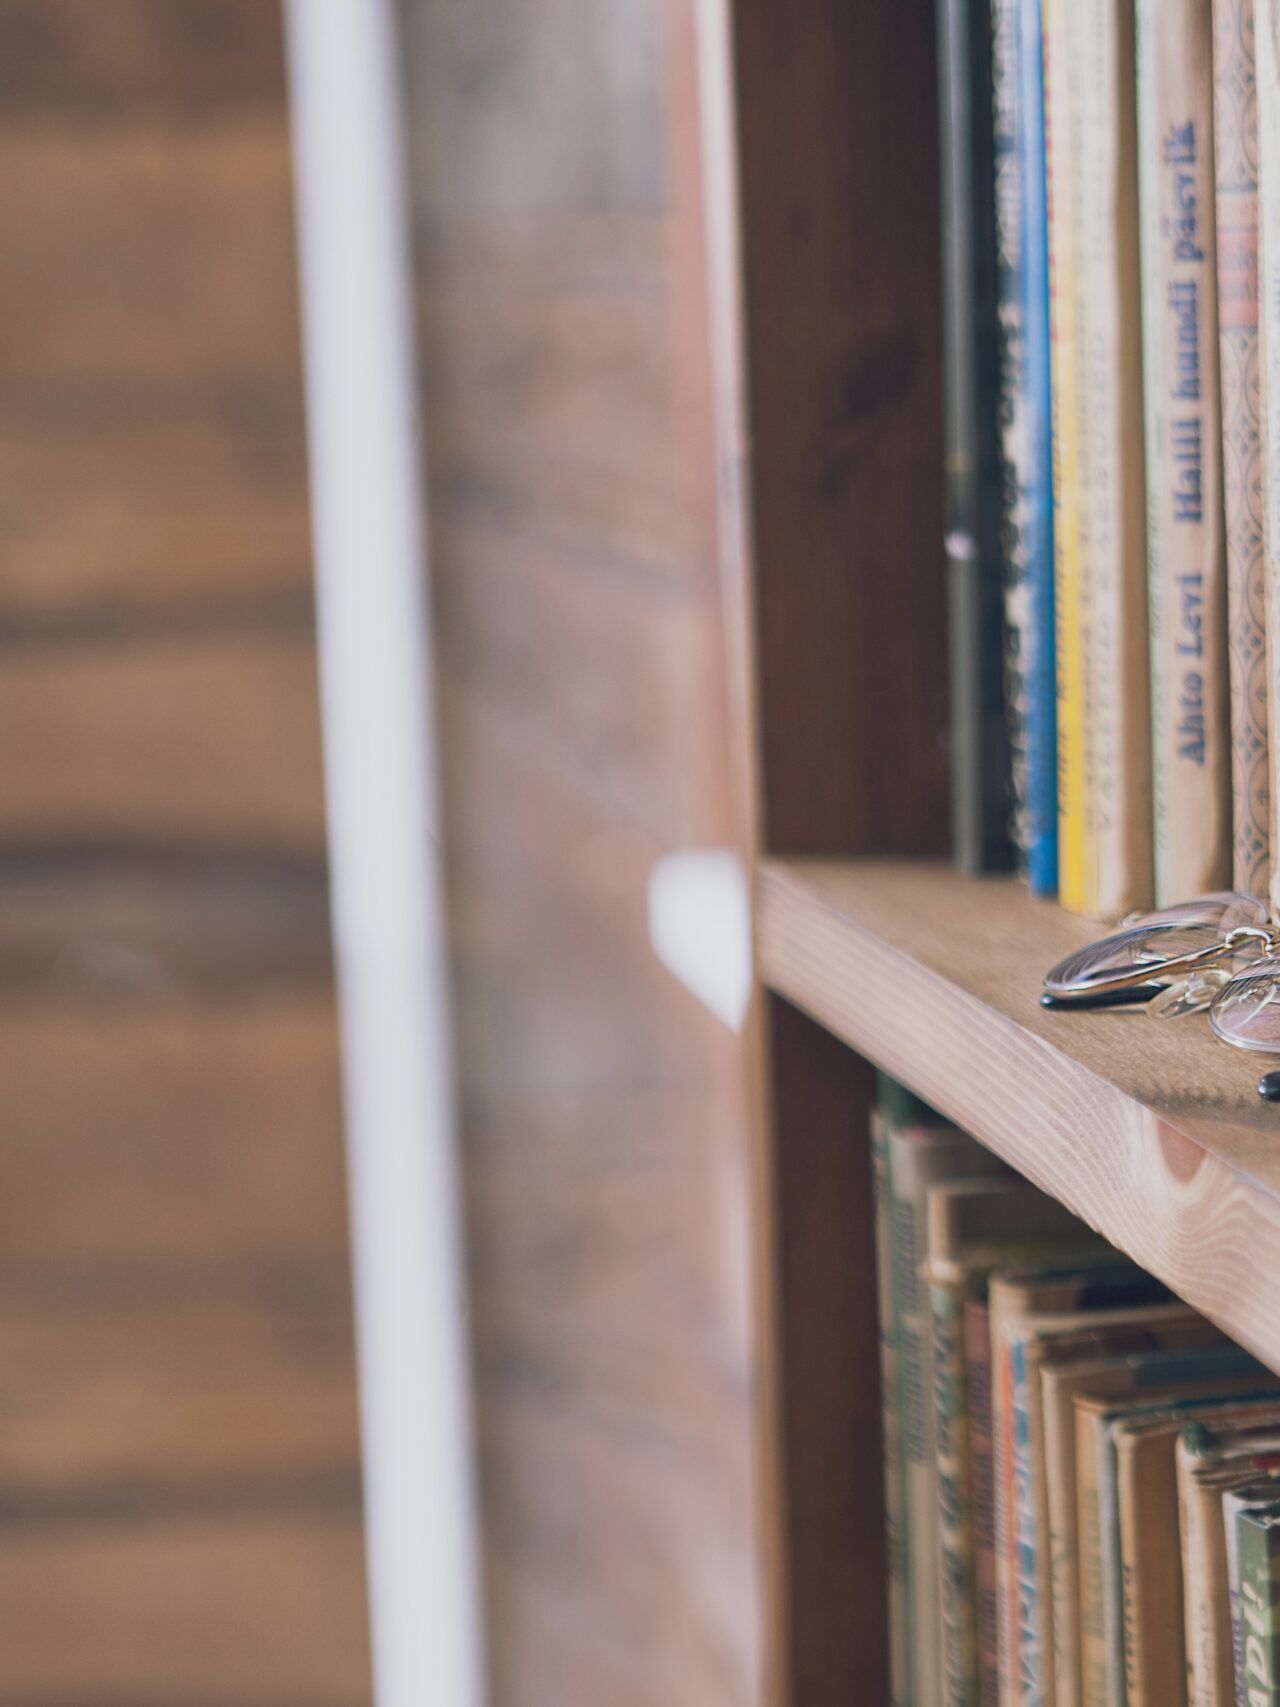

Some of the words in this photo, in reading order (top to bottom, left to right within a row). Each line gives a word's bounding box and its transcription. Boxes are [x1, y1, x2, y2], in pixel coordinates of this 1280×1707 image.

[1161, 119, 1205, 262] päevik
[1167, 280, 1200, 401] hundi
[1170, 418, 1203, 524] Halli
[1174, 572, 1204, 657] Levi
[1174, 673, 1207, 765] Ahto
